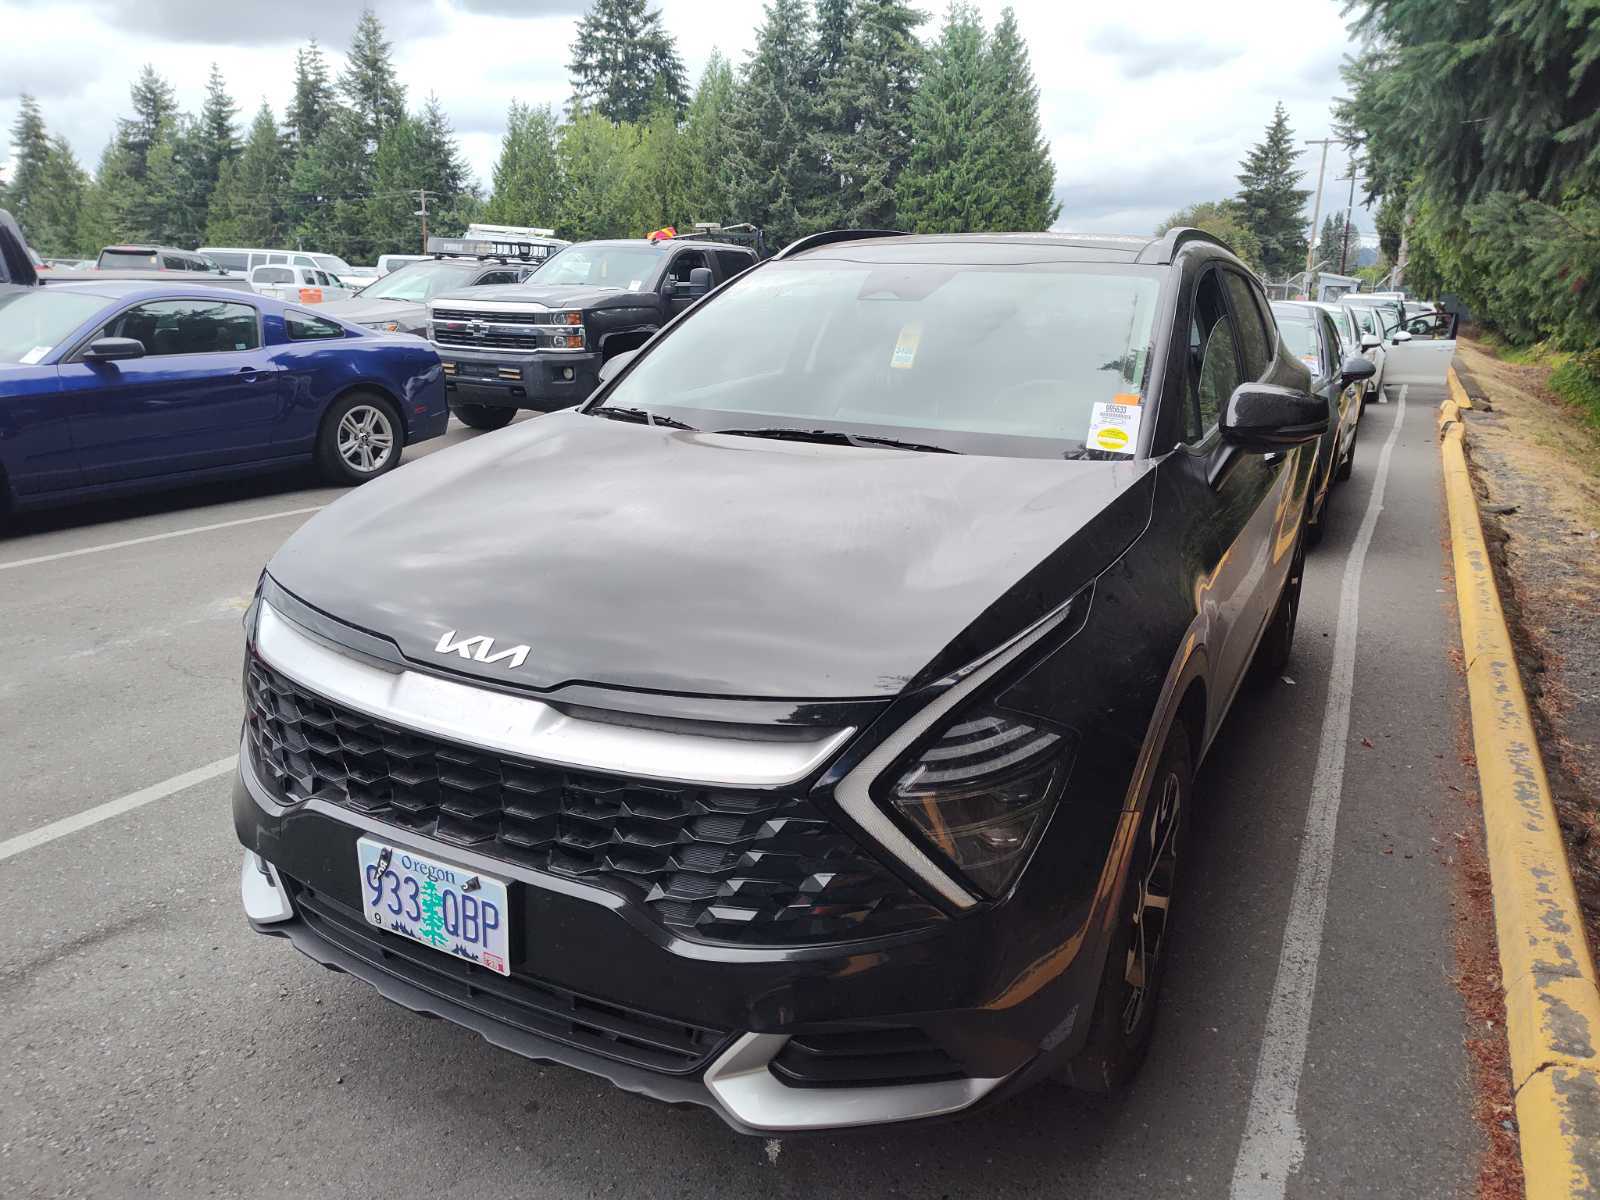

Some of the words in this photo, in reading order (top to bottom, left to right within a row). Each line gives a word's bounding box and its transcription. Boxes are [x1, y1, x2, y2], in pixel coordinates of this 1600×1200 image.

[434, 629, 532, 669] KIA
[401, 855, 455, 884] Oregon
[366, 864, 421, 922] 933
[442, 889, 499, 948] QBP
